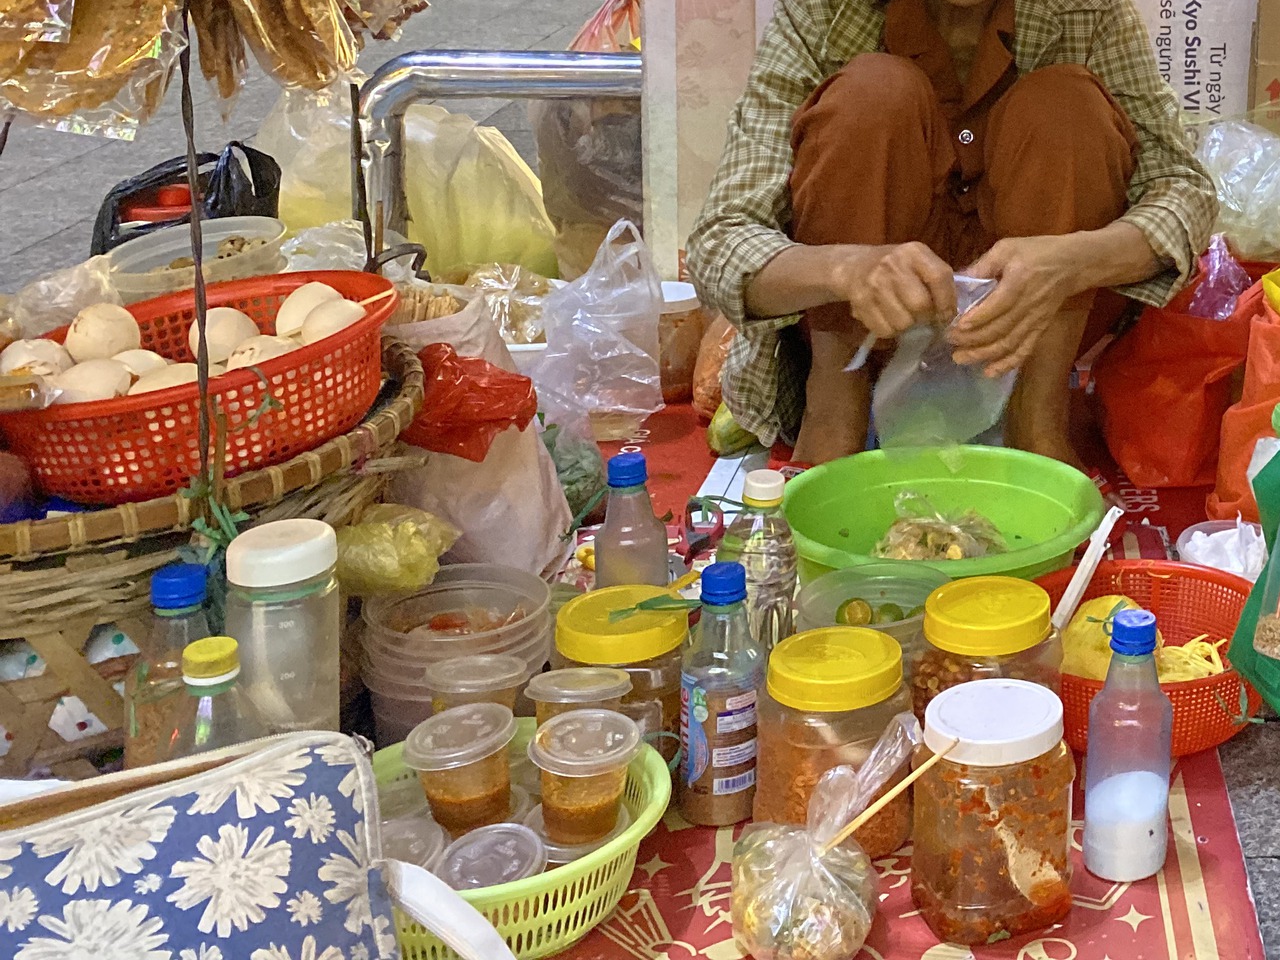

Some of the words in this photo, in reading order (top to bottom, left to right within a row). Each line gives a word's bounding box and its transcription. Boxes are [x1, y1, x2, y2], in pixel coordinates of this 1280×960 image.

[1160, 0, 1175, 19] sẽ
[1184, 36, 1202, 86] Sushi
[1210, 43, 1226, 66] Từ
[1206, 72, 1225, 115] ngày
